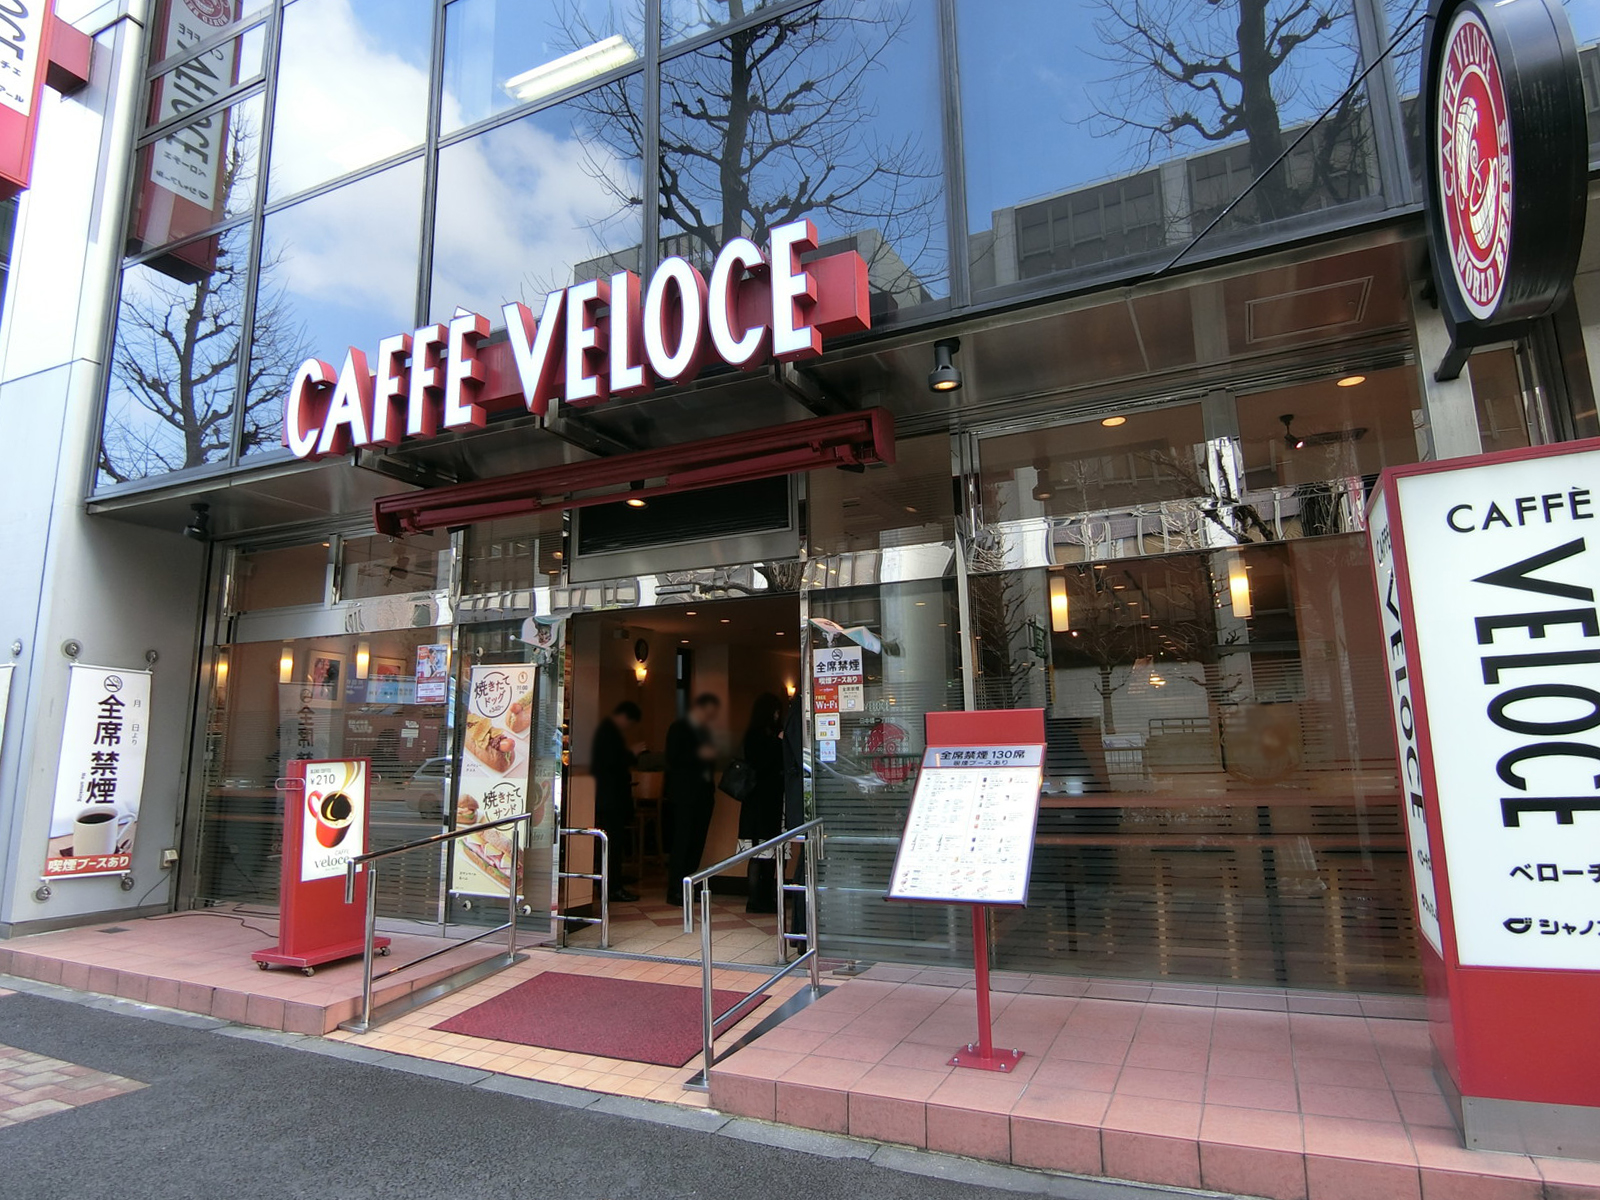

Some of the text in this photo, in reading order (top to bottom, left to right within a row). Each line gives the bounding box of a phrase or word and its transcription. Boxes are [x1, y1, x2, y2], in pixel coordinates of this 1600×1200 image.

[1453, 26, 1492, 84] VELOCE
[1457, 235, 1495, 302] WORLD
[283, 217, 815, 459] CAFFÈ VELOCE
[1446, 486, 1595, 533] CAFFÈ
[816, 658, 860, 673] 全席禁煙
[474, 675, 511, 700] 焼きたて
[1470, 536, 1600, 828] VELOCE
[484, 690, 506, 708] ドッグ
[815, 700, 838, 710] Wi-Fi
[1386, 567, 1427, 826] VELOCE
[85, 693, 126, 804] 全席禁煙
[940, 749, 1026, 760] 全席禁煙 130席
[310, 773, 336, 786] ¥210
[482, 787, 522, 810] 焼きたて
[493, 803, 517, 819] サンド
[48, 856, 130, 873] 喫煙ブースあり
